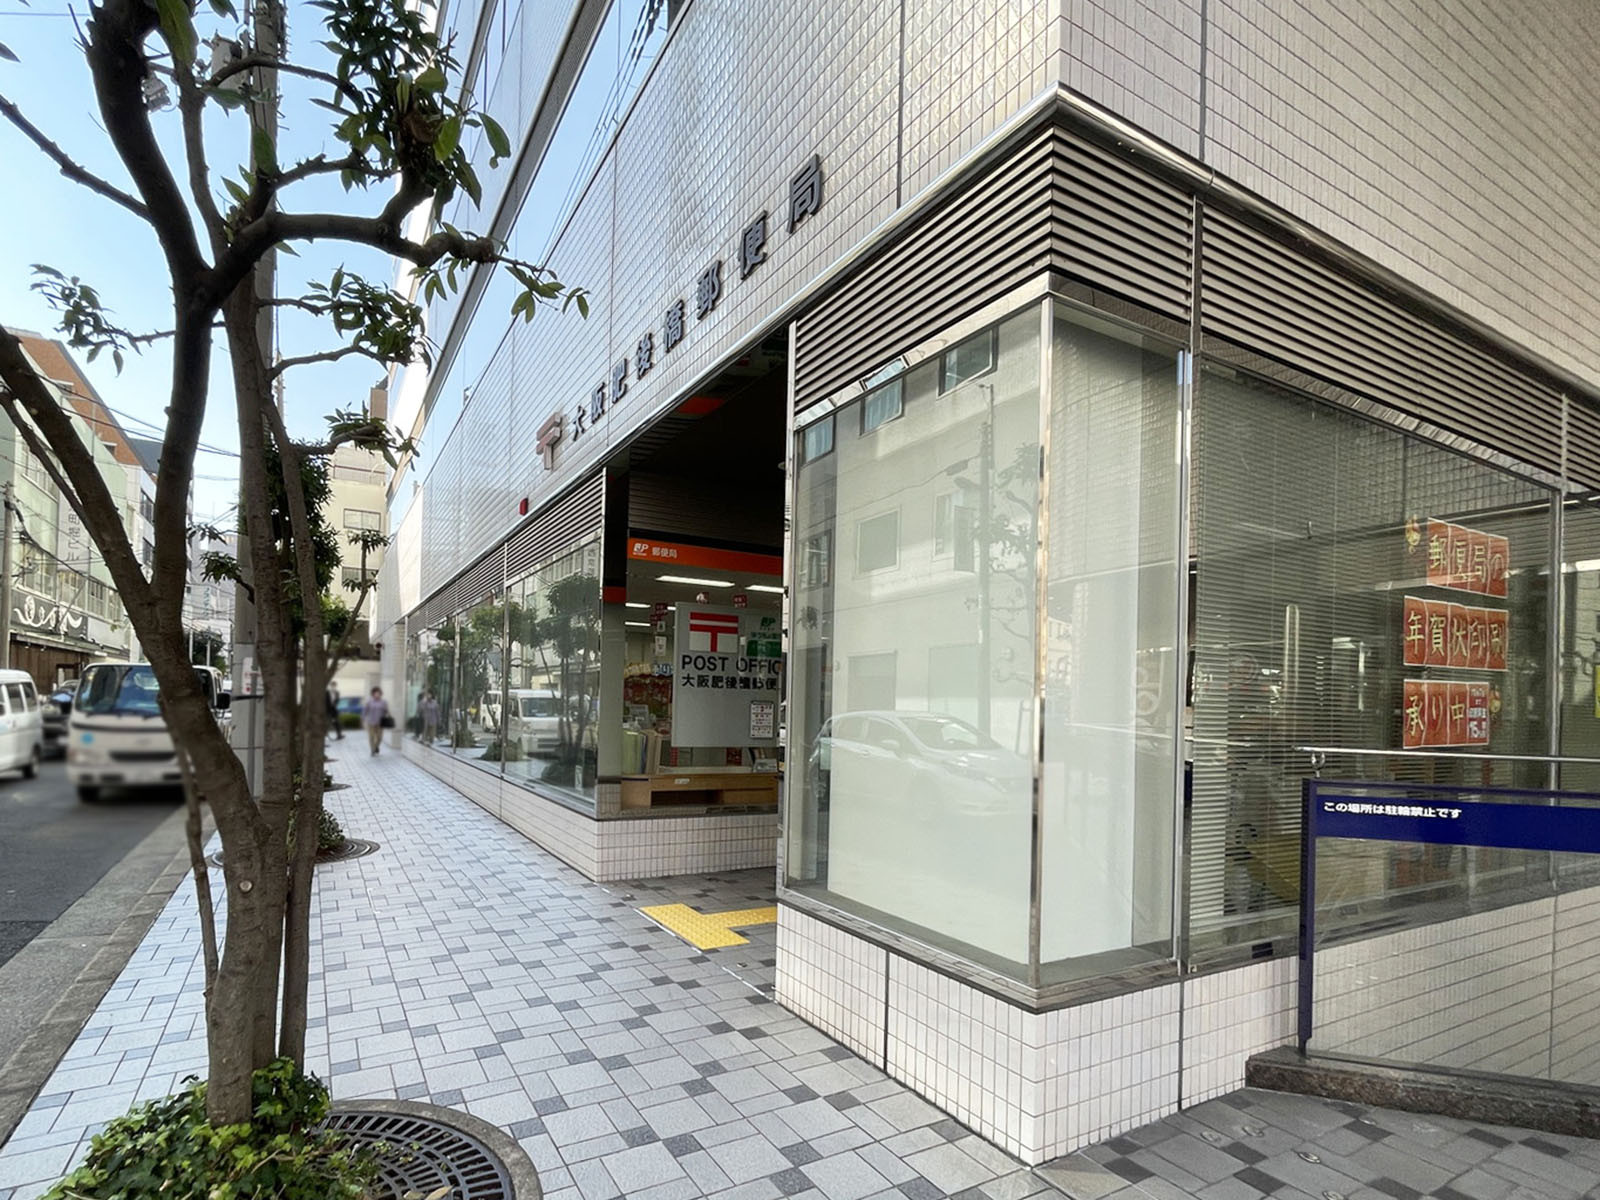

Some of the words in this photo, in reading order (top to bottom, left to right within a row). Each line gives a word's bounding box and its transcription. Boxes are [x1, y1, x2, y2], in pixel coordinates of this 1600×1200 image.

[573, 153, 823, 441] 大阪肥後橋郵便局
[652, 547, 677, 559] 郵便局
[1429, 534, 1505, 584] 郵便局の
[1405, 610, 1506, 660] 年賀状印刷
[682, 654, 729, 672] POST
[1406, 695, 1465, 737] 承り中
[1324, 801, 1462, 819] この場所は駐輪禁止です
